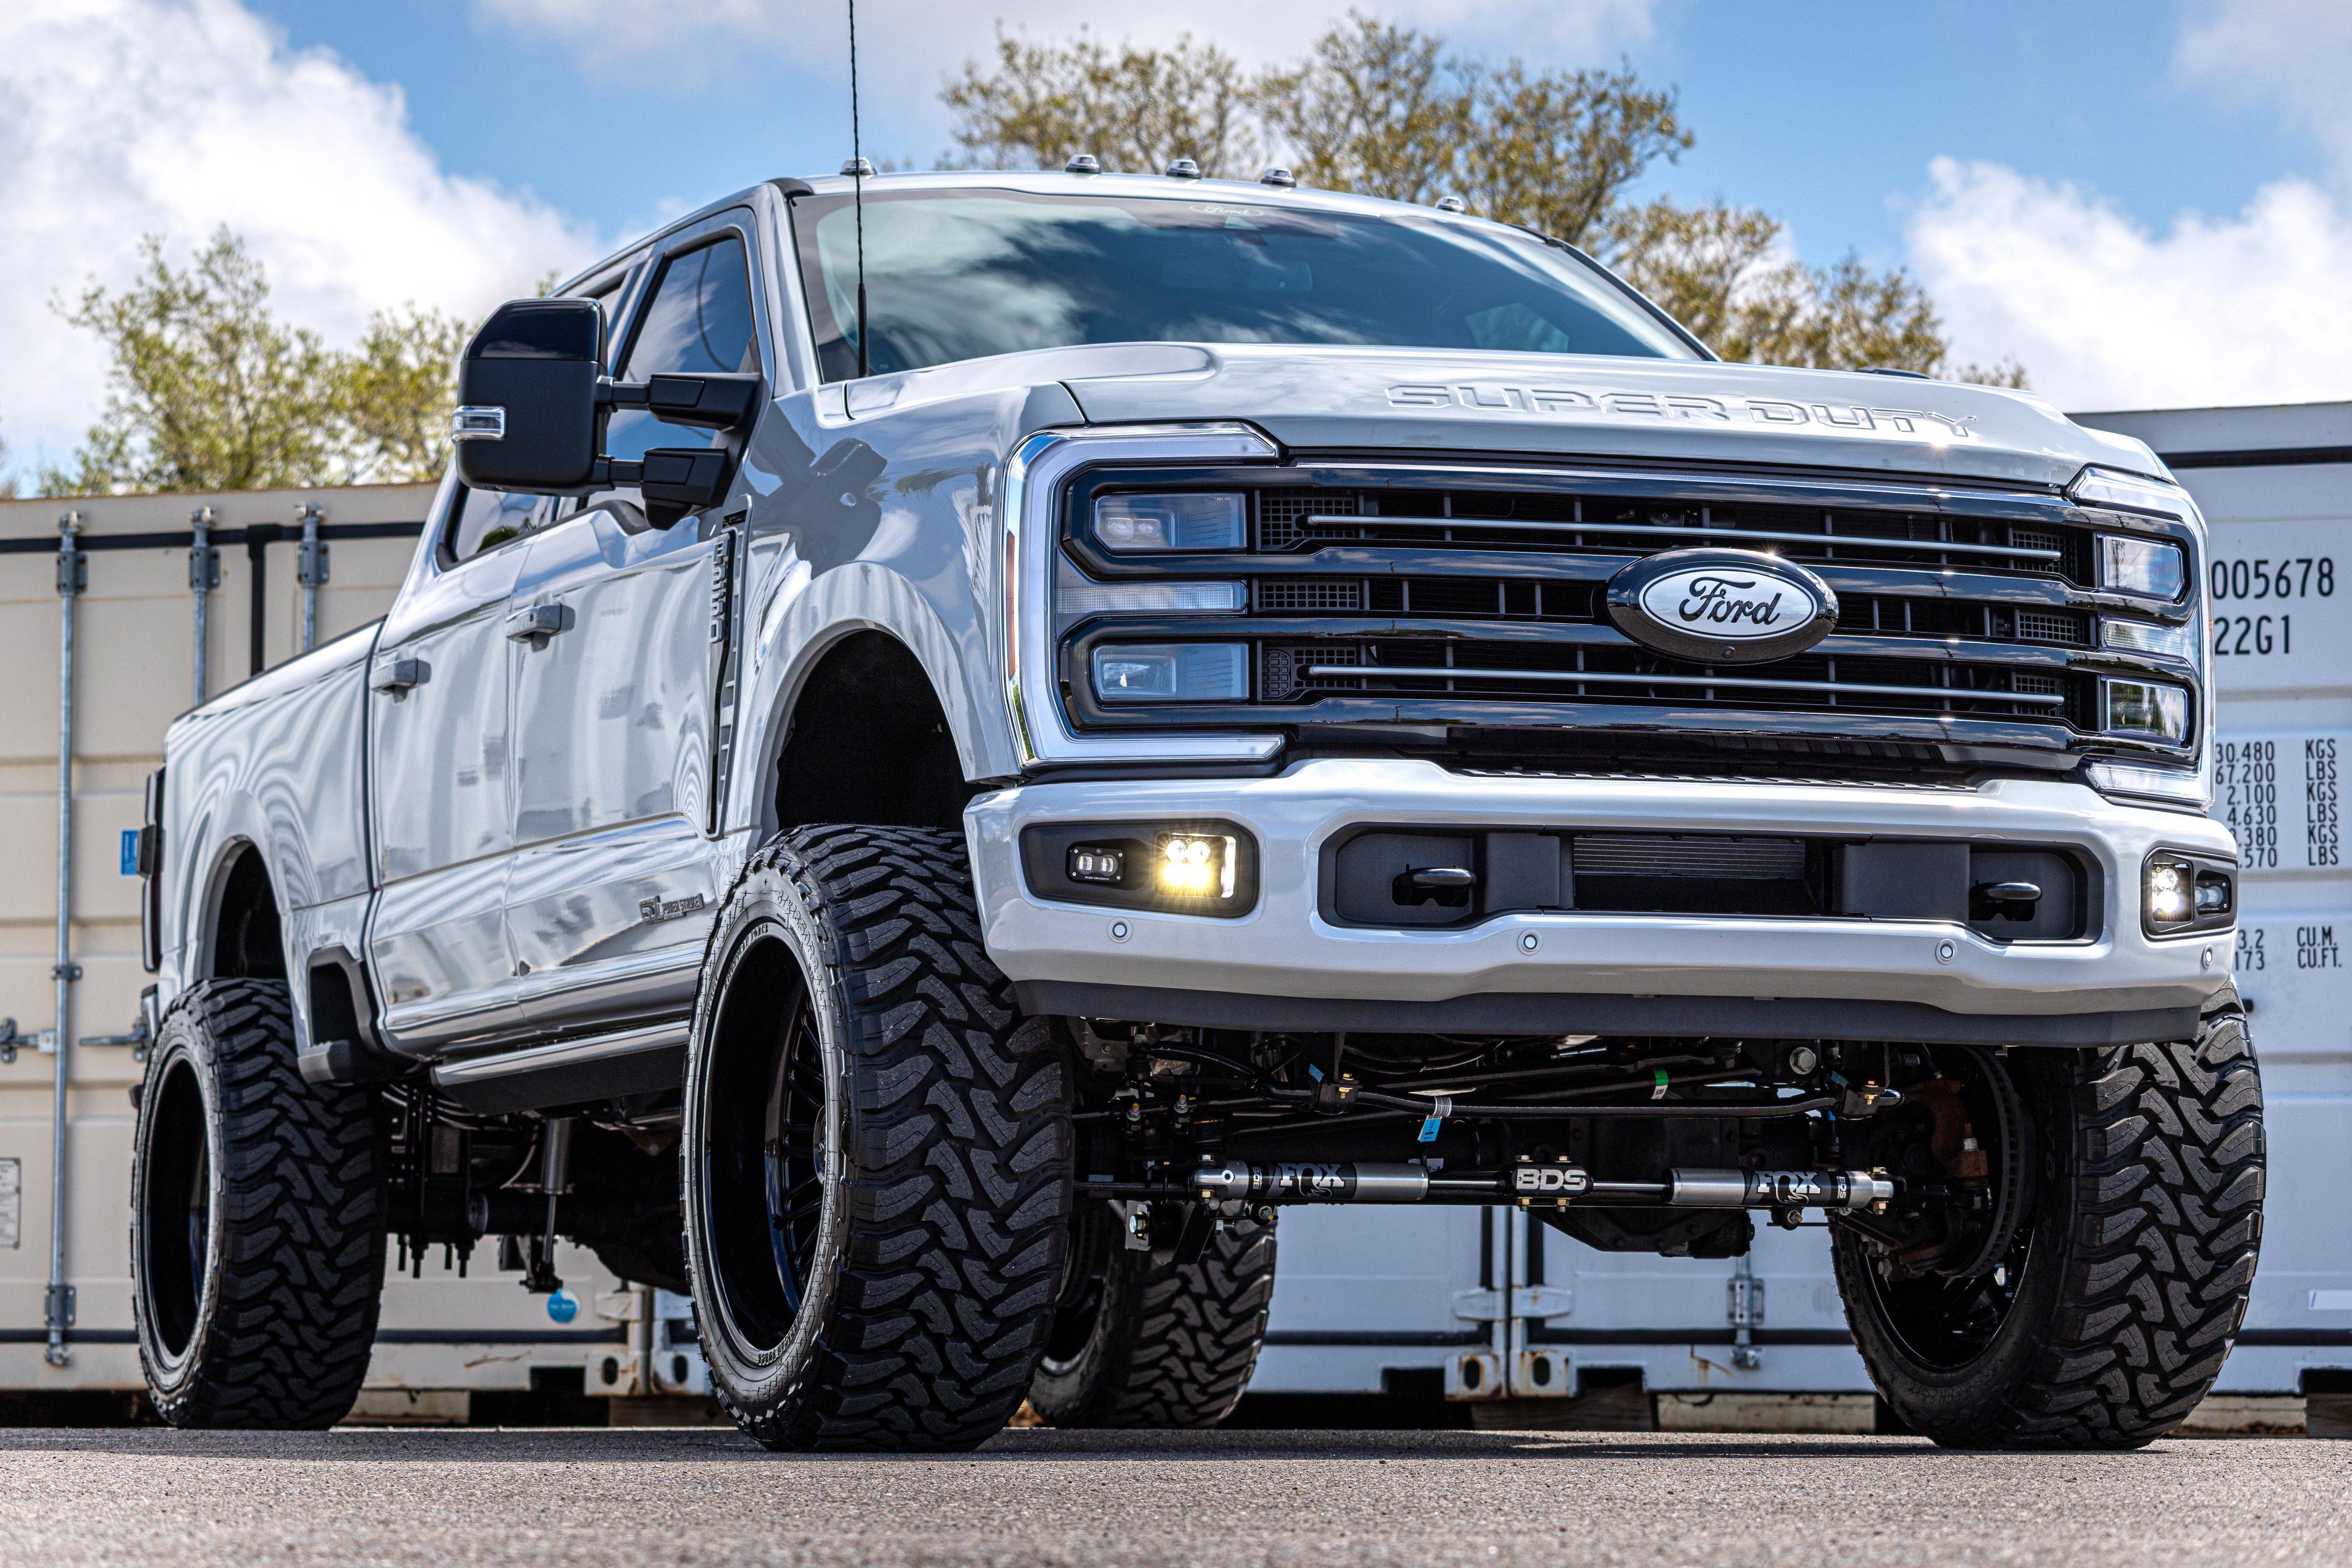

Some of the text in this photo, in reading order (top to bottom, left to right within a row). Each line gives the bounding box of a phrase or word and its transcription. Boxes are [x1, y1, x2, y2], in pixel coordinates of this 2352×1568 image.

[1204, 205, 1250, 215] Ford
[1383, 385, 1979, 438] SUPER DUTY
[2212, 557, 2334, 600] 005678
[1679, 576, 1783, 626] Ford
[2214, 615, 2290, 656] 22G1
[2215, 739, 2336, 764] 30.480 KGS
[2215, 760, 2337, 785] 67.200 LBS
[2227, 781, 2337, 805] 2.100 KGS
[2227, 802, 2338, 826] 4.630 LBS
[2229, 824, 2339, 847] .380 KGS
[2239, 845, 2339, 869] .570 LBS
[751, 923, 769, 942] FORCE
[2238, 929, 2264, 950] 3.2
[2234, 950, 2265, 971] 173
[1277, 1163, 1345, 1198] FOX
[1516, 1169, 1586, 1190] BDS
[1756, 1170, 1821, 1205] FOX
